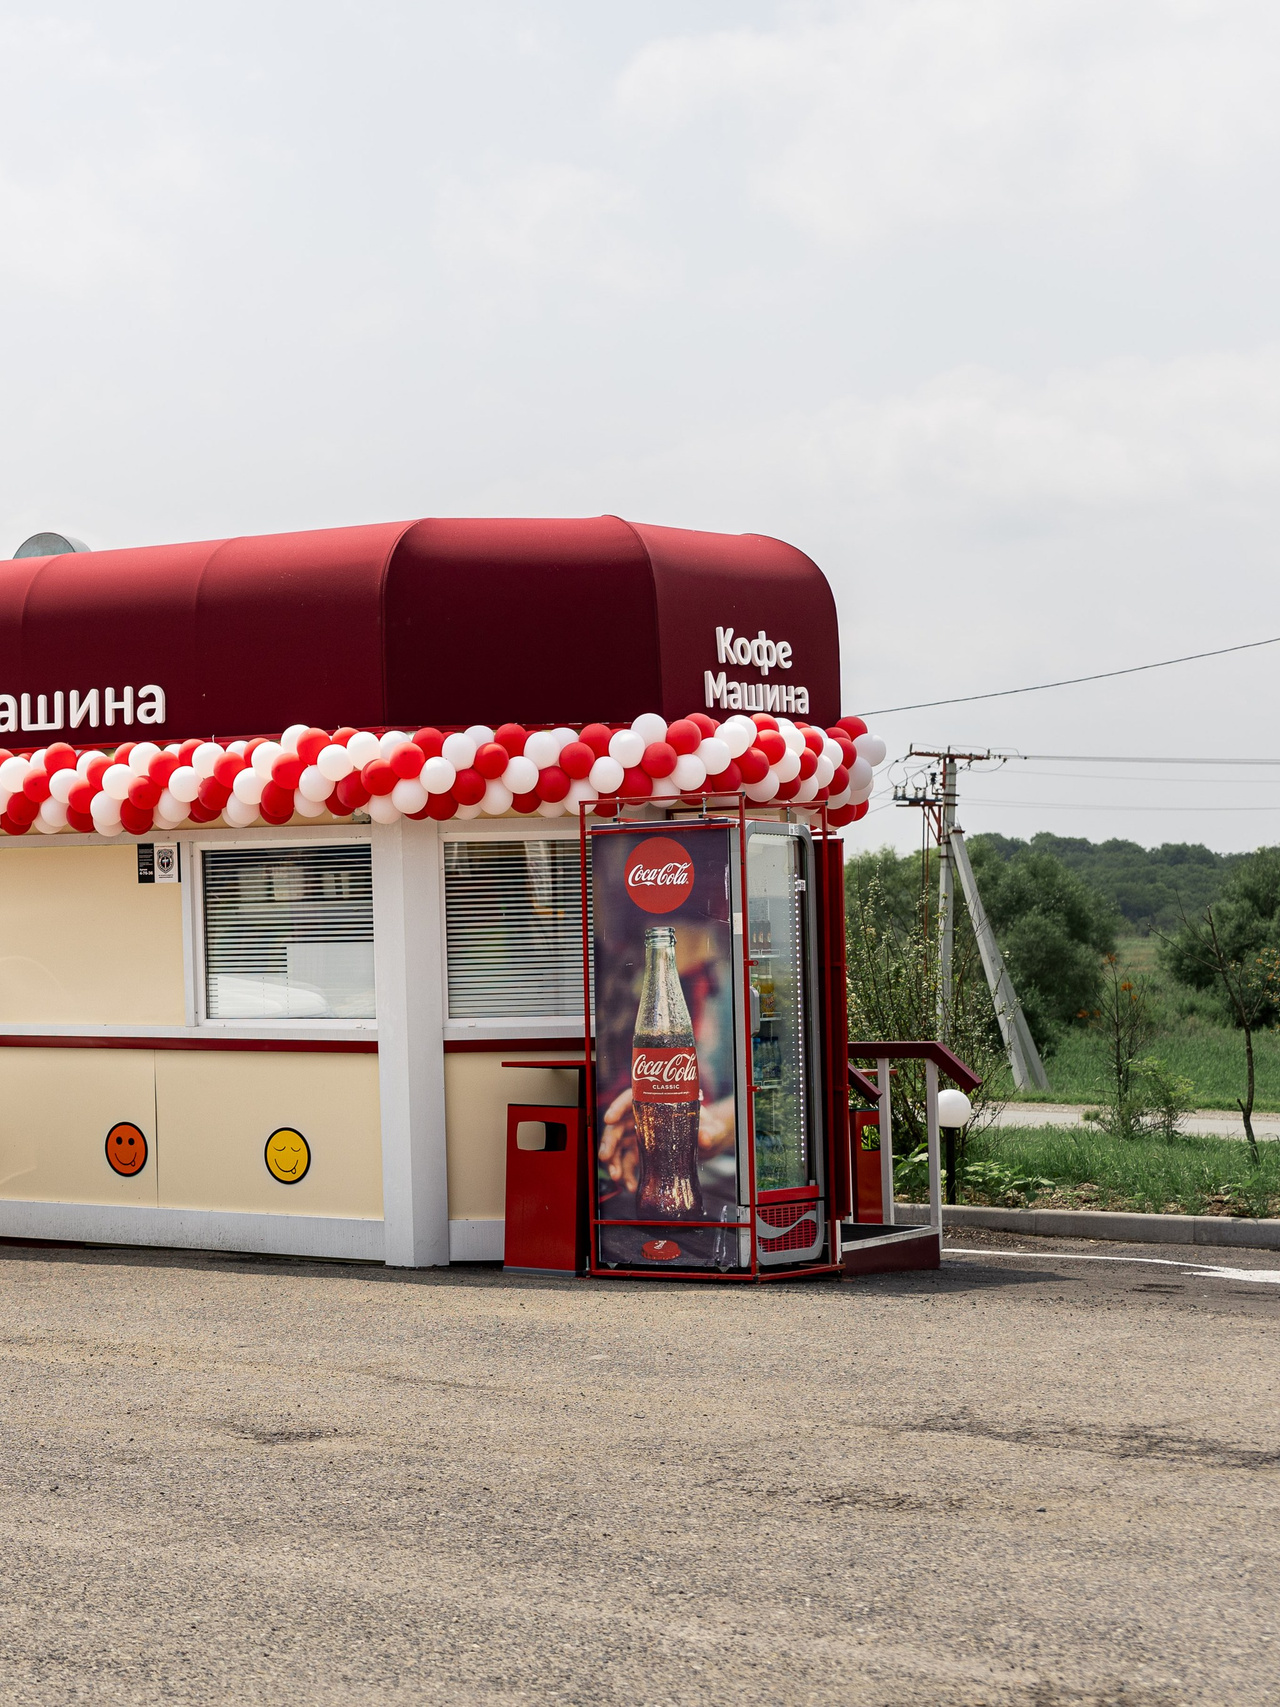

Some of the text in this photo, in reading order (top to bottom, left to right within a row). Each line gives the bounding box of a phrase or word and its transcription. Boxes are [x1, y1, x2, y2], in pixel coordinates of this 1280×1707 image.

[716, 626, 792, 676] Кофе
[704, 670, 809, 714] Машина
[628, 862, 692, 887] Coca-Cola
[632, 1053, 697, 1082] Coca-Cola
